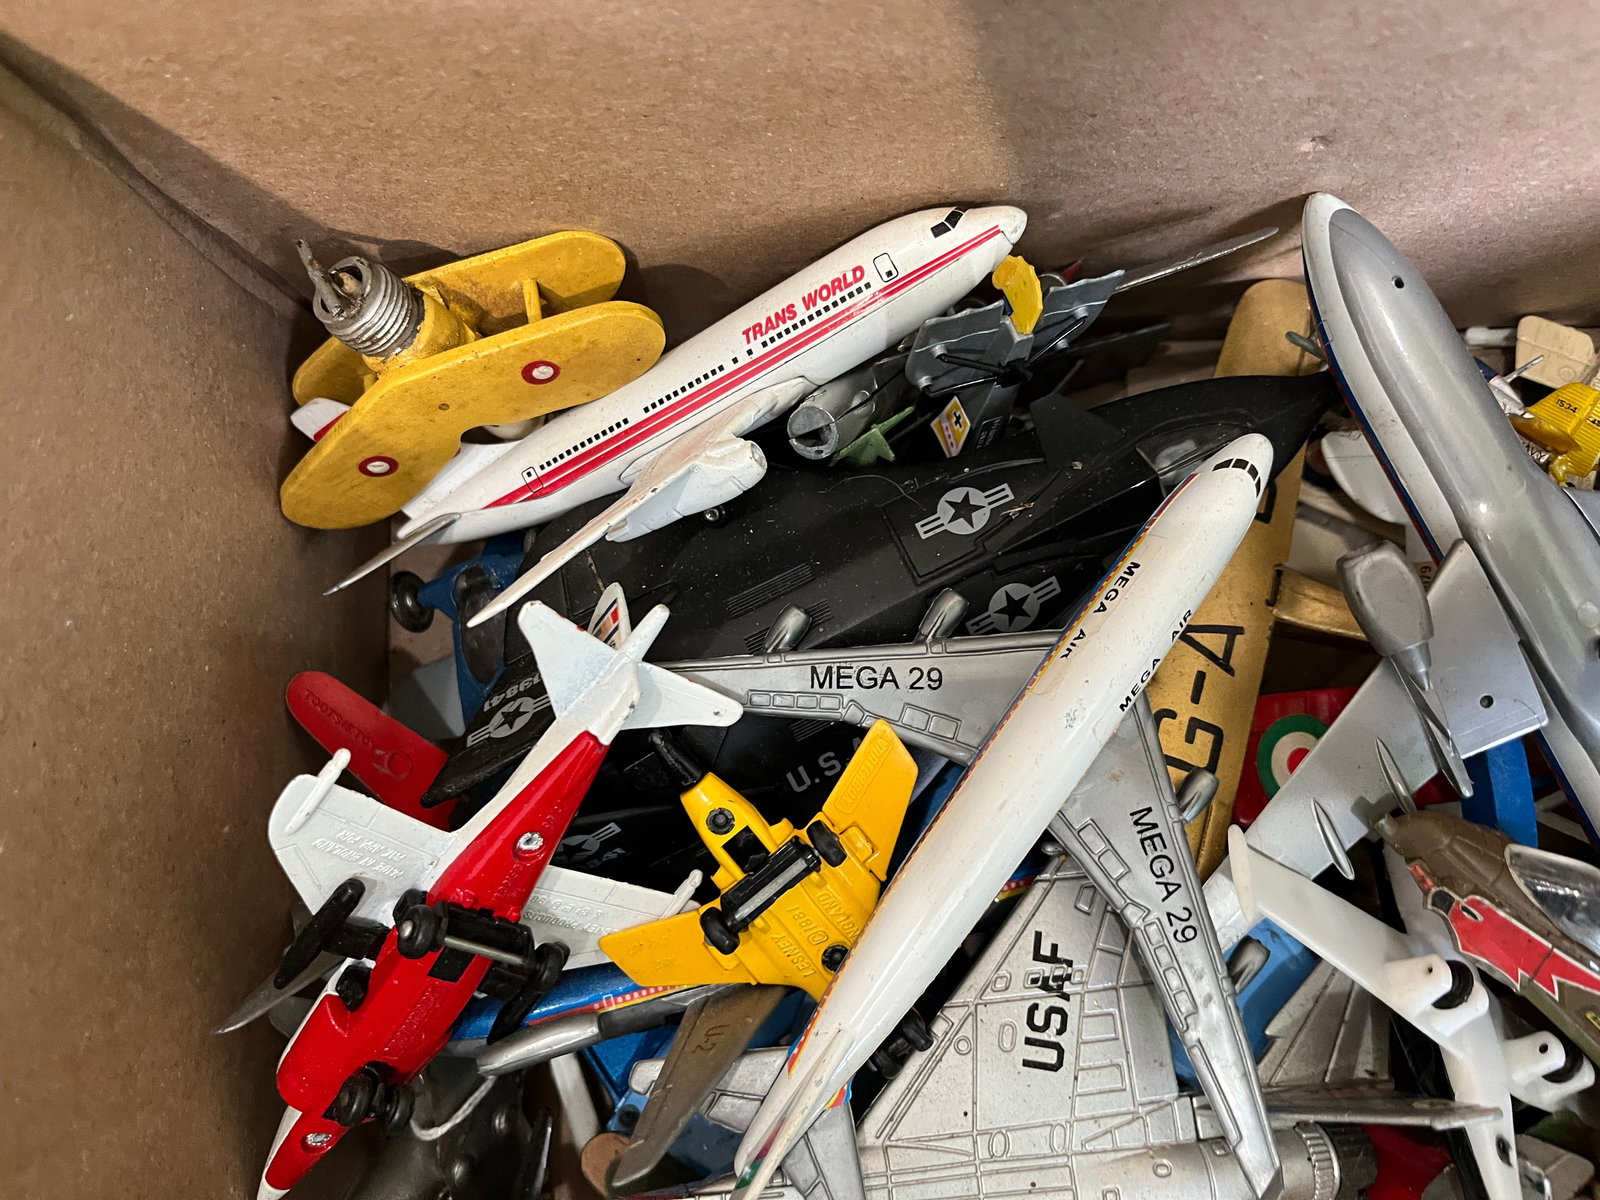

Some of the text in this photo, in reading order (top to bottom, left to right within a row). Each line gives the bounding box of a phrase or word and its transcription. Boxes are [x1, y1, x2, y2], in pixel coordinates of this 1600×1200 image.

[742, 265, 865, 345] TRANS WORLD
[1060, 561, 1141, 659] MEGA AIR
[810, 665, 943, 691] MEGA 29
[1119, 609, 1193, 712] MEGA AIR
[816, 889, 861, 940] NGLAND
[1129, 806, 1198, 943] MEGA 29
[770, 931, 818, 978] LESNEY
[1022, 930, 1073, 1072] USAF
